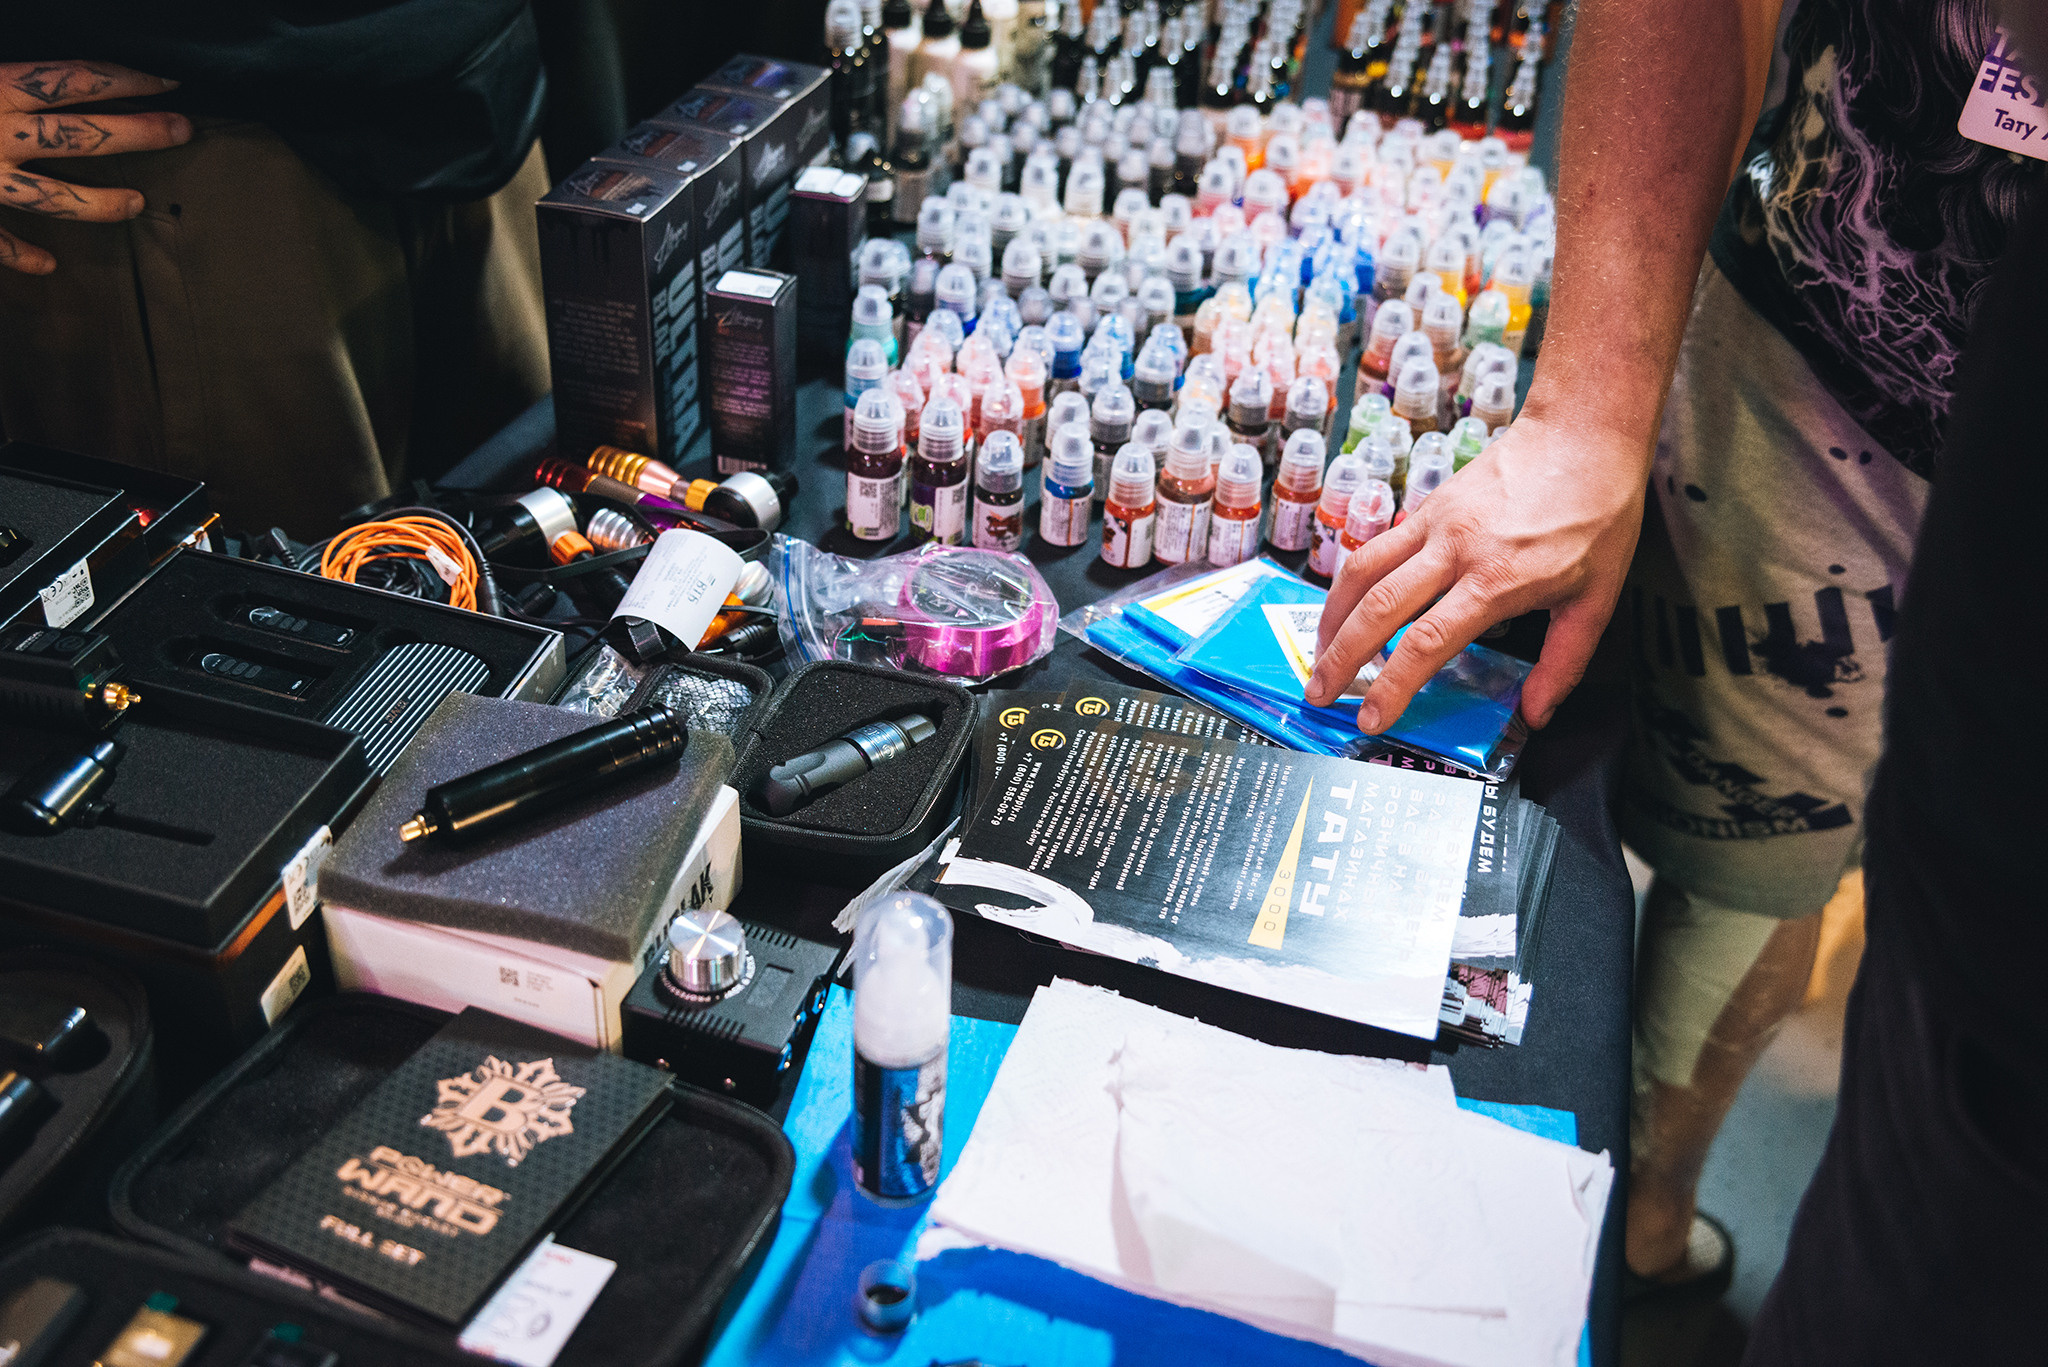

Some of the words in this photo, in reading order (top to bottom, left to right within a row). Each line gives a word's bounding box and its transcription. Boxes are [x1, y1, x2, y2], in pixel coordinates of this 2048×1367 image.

[668, 259, 700, 456] ULTRA
[999, 732, 1008, 742] +7
[1075, 731, 1098, 768] Розничные
[1088, 733, 1108, 767] наличием
[995, 744, 1007, 764] (800)
[1022, 752, 1033, 763] +7
[1052, 729, 1087, 790] Санкт-Петербурге,
[1095, 735, 1119, 780] собственные
[1124, 739, 1142, 767] продаж,
[1135, 748, 1152, 773] Вашим
[1149, 743, 1165, 769] сервис
[1157, 745, 1176, 780] качество,
[1171, 747, 1189, 778] Покупая
[1200, 751, 1210, 765] вся
[1220, 755, 1233, 779] ценим
[1235, 757, 1247, 770] Мы
[1009, 763, 1028, 785] (800)
[1114, 769, 1130, 794] служба
[1206, 753, 1222, 784] ведущих
[1254, 761, 1269, 790] вершин
[1280, 765, 1293, 786] Наша
[1007, 762, 1043, 822] www.t3supply.ru
[1059, 775, 1077, 804] оптовые
[1067, 767, 1093, 815] необходимого
[1084, 781, 1100, 806] склады
[1124, 774, 1141, 803] услугам
[1136, 776, 1152, 803] заботу.
[1146, 782, 1163, 812] честные
[1186, 766, 1205, 805] продукция
[1213, 780, 1227, 801] Ваше
[1224, 771, 1241, 805] дорожим
[1260, 763, 1280, 808] инструмент,
[1274, 787, 1285, 806] цель
[990, 786, 1018, 826] 555-09-79
[1099, 795, 1119, 829] доставки,
[1113, 803, 1129, 830] единый
[1194, 786, 1211, 819] мировых
[1244, 791, 1259, 820] успеха.
[1044, 805, 1064, 838] магазины
[1056, 816, 1072, 840] запаса
[1063, 812, 1087, 854] постоянным
[1074, 808, 1101, 857] специалистов,
[1136, 813, 1151, 834] цены,
[1149, 827, 1160, 838] Вы
[1167, 806, 1191, 859] оригинальная.
[1201, 802, 1218, 836] доверие.
[1216, 806, 1230, 831] нашей
[1250, 810, 1266, 843] который
[1093, 830, 1105, 848] штат
[1131, 835, 1142, 851] наш
[1181, 820, 1201, 854] брендов,
[1259, 815, 1277, 855] подобрать
[1298, 777, 1359, 917] ТАТУ
[1477, 805, 1497, 873] БУДЕМ
[1024, 844, 1047, 872] Москве,
[1041, 841, 1061, 870] товаров.
[1134, 839, 1154, 876] получаете
[1184, 838, 1208, 886] Представляя
[1200, 832, 1221, 876] репутацией
[1239, 844, 1256, 879] позволит
[1255, 855, 1265, 870] для
[1331, 781, 1381, 922] МАГАЗИНАХ
[1087, 870, 1101, 890] отдел
[1115, 852, 1136, 891] искренний
[1162, 855, 1187, 904] гарантируем,
[1250, 872, 1262, 887] Вас
[1174, 887, 1190, 914] товары
[1190, 884, 1203, 907] очень
[1229, 879, 1244, 911] достичь
[1246, 888, 1255, 901] тот
[1262, 869, 1291, 932] 3000
[1158, 906, 1169, 919] что
[1170, 915, 1179, 925] от
[370, 1145, 504, 1206] POWER
[337, 1158, 499, 1235] WAND
[378, 1239, 427, 1266] SET
